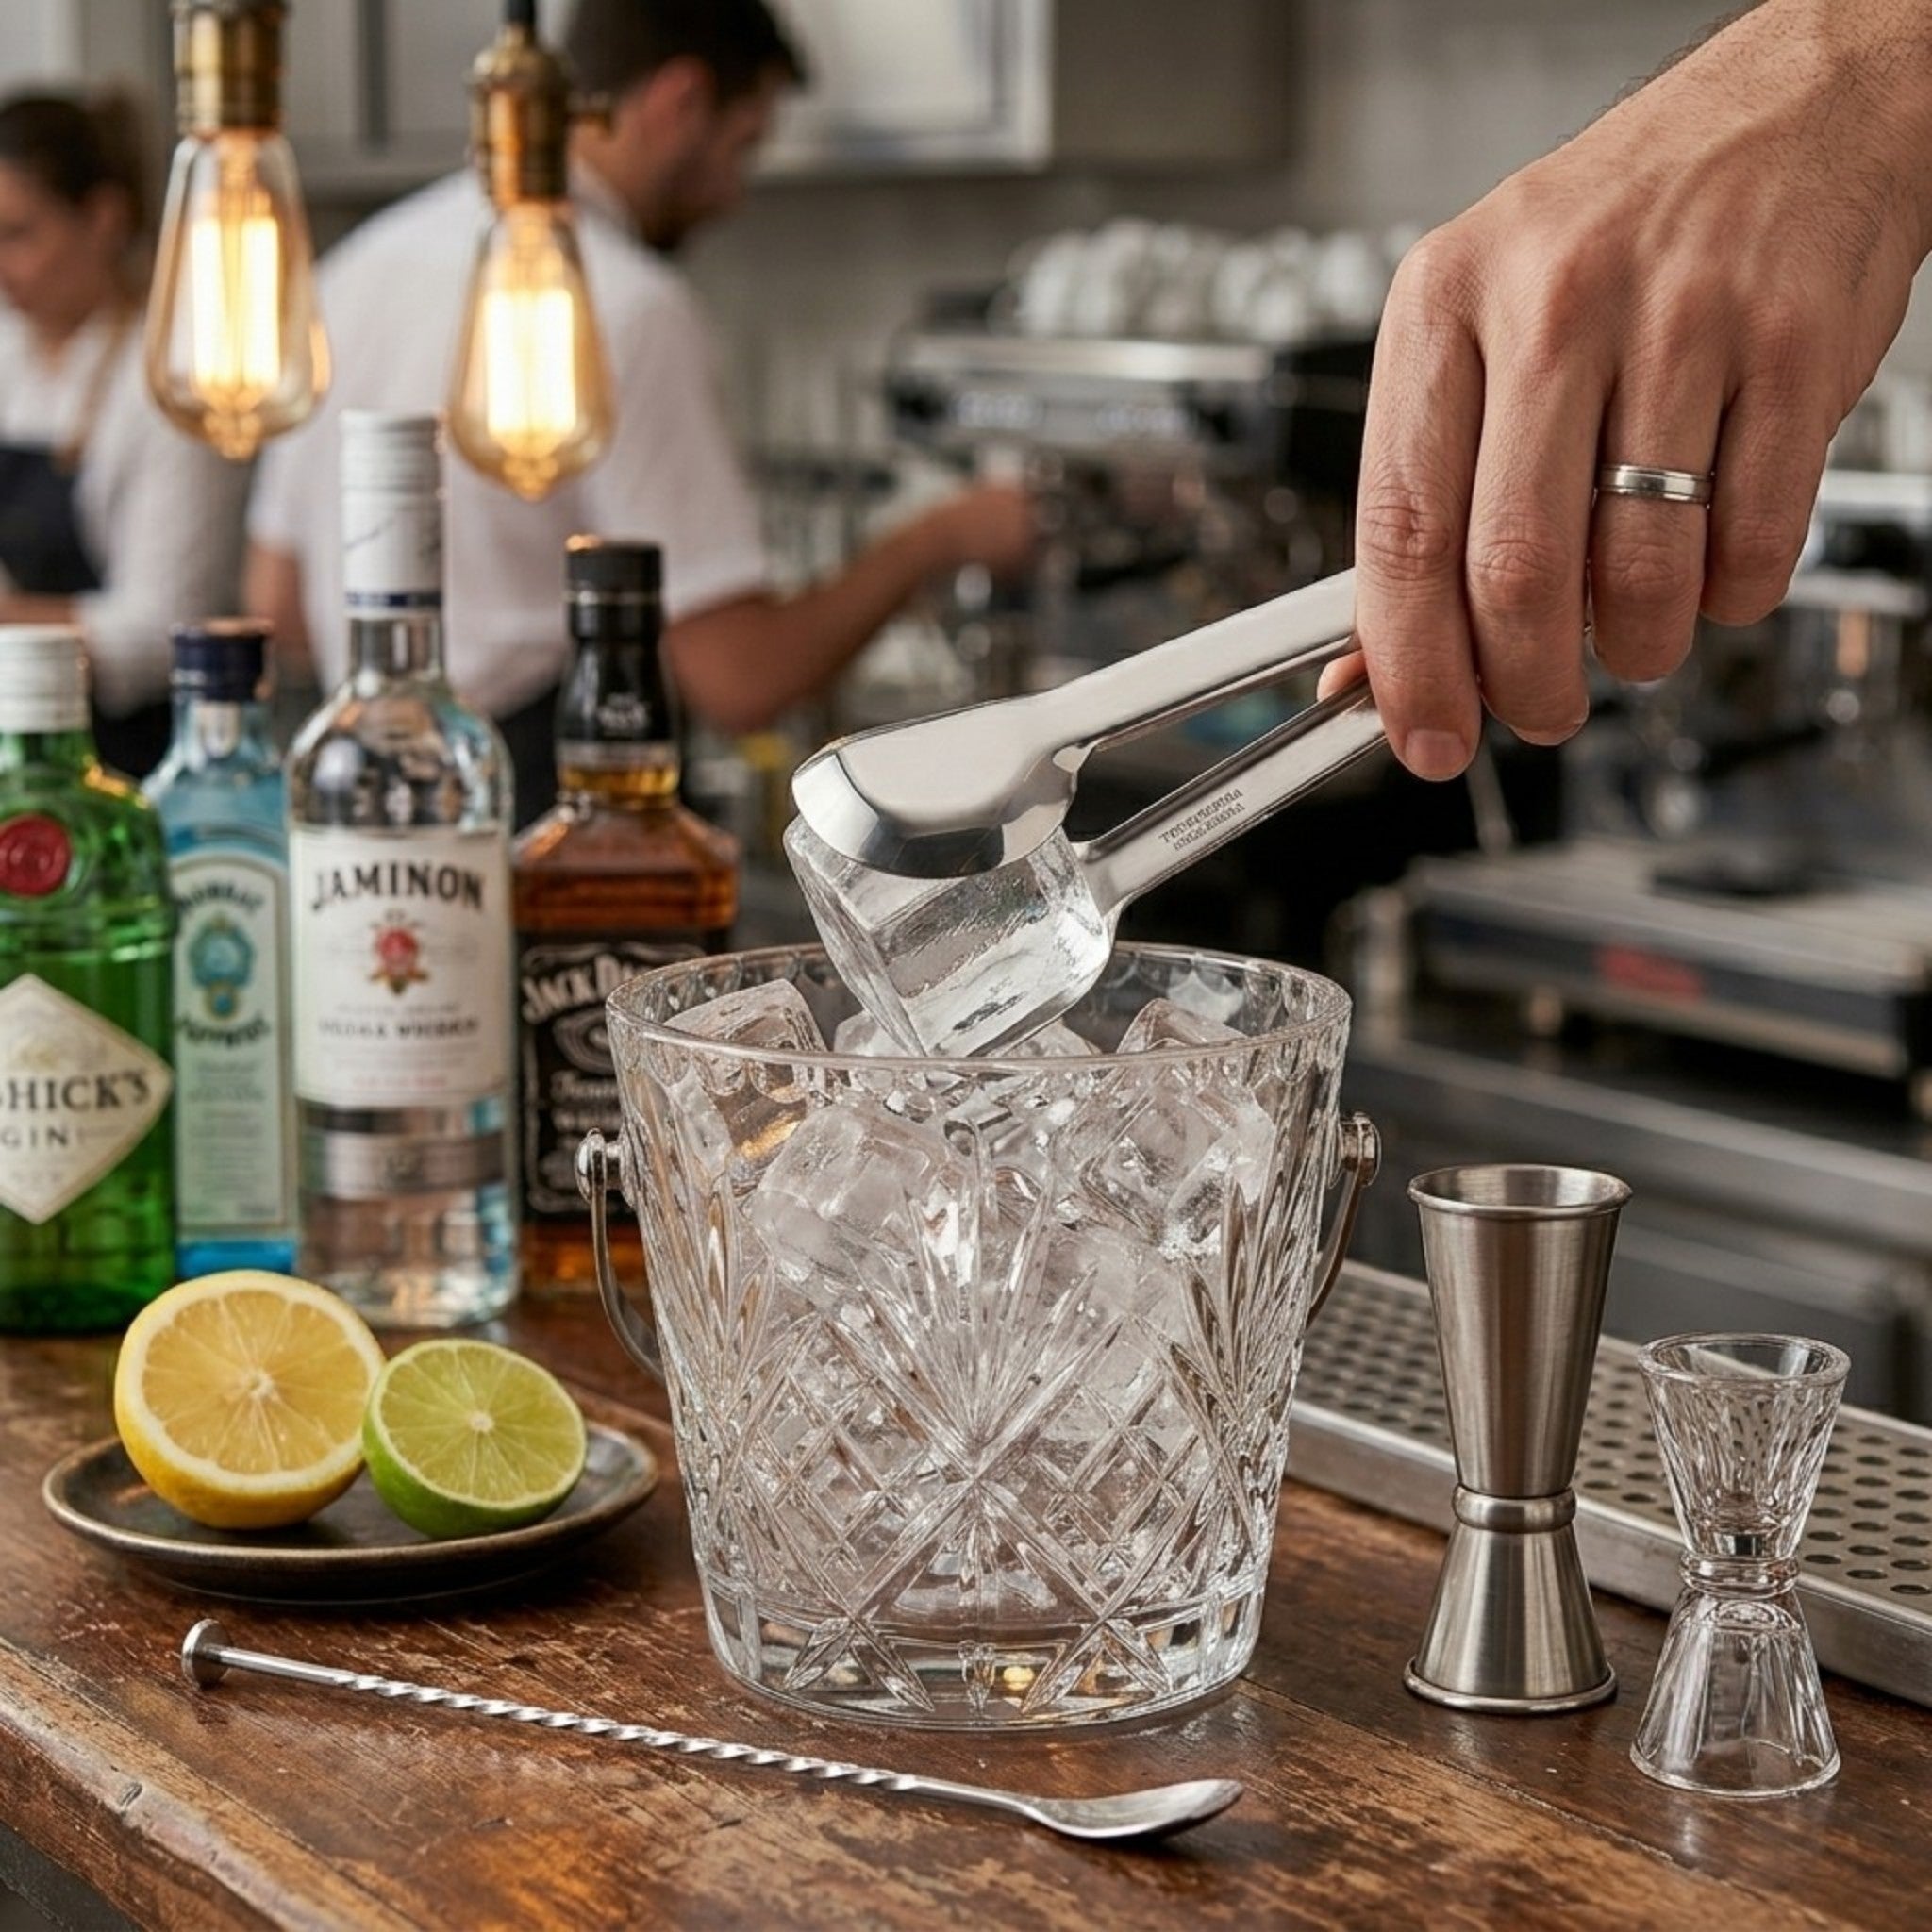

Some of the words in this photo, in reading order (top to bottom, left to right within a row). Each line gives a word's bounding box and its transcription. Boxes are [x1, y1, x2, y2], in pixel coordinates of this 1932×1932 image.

[311, 861, 484, 913] JAMINON
[522, 966, 597, 1023] JACK
[0, 1068, 150, 1113] HICK'S
[1, 1126, 69, 1150] GIN
